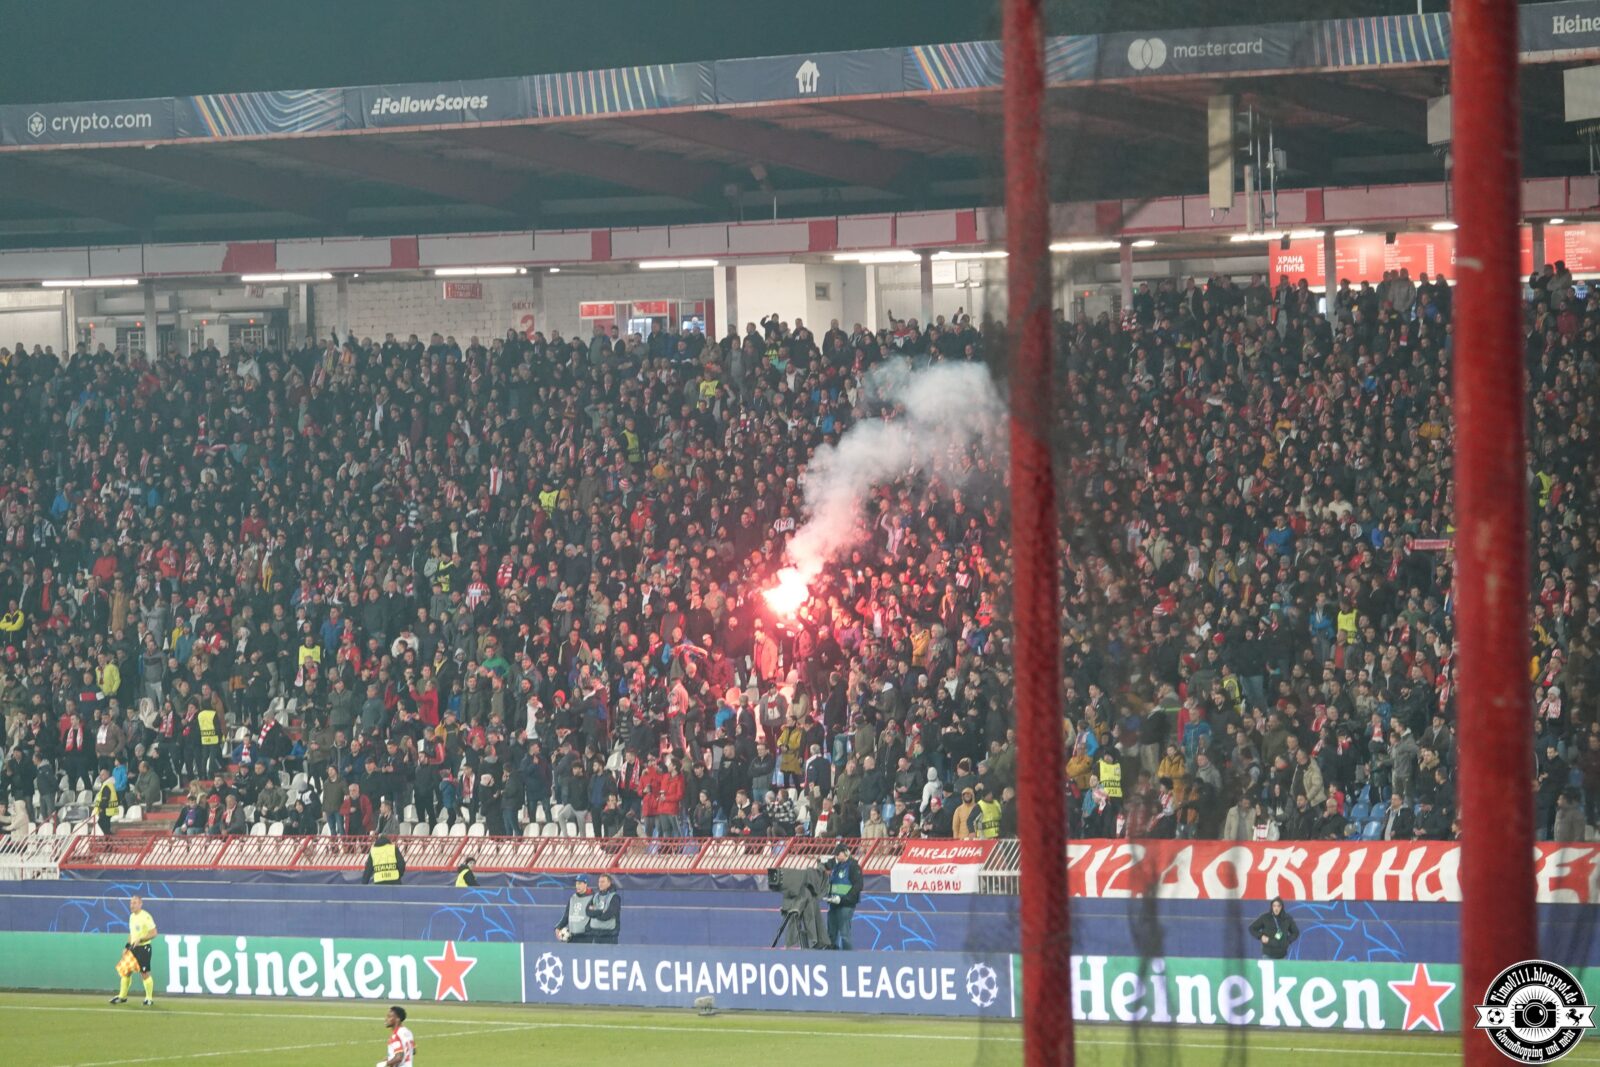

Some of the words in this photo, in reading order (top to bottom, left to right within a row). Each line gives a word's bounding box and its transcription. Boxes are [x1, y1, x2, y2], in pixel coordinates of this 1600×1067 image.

[1173, 37, 1263, 58] mastercard
[52, 112, 152, 134] crypto.com
[1275, 264, 1282, 273] И
[1277, 255, 1304, 265] ХРАНА
[906, 879, 962, 892] РАДОВИШ
[164, 935, 422, 1000] Heineken
[572, 959, 647, 992] UEFA
[655, 960, 829, 998] CHAMPIONS
[841, 965, 957, 1000] LEAGUE
[1070, 955, 1386, 1030] Heineken
